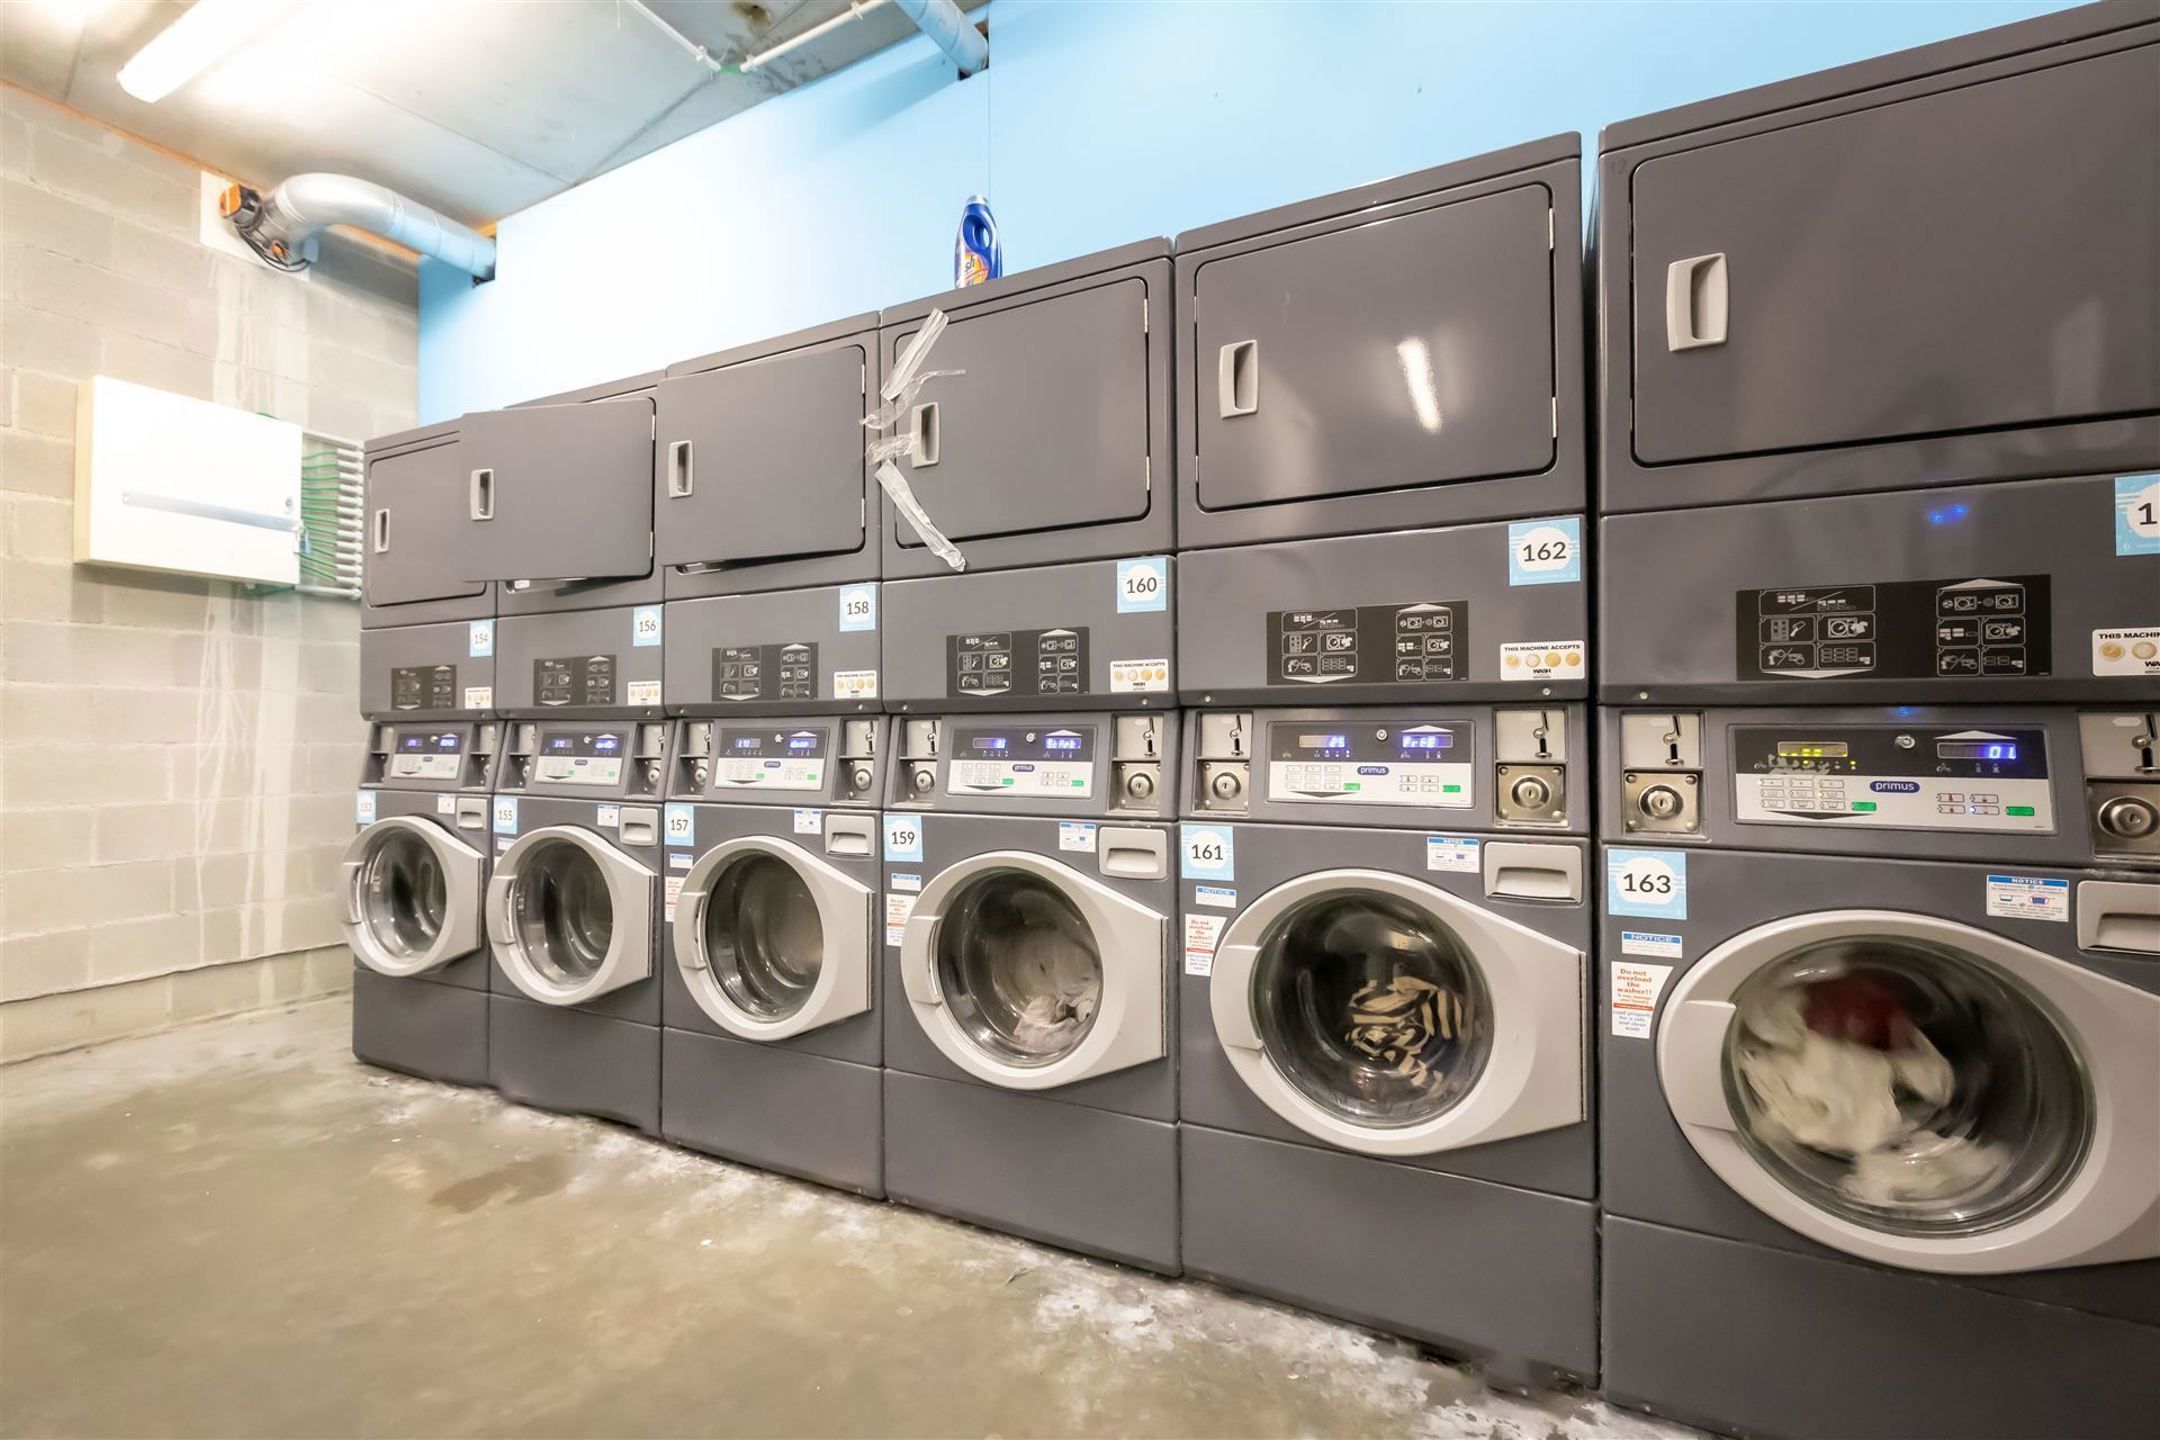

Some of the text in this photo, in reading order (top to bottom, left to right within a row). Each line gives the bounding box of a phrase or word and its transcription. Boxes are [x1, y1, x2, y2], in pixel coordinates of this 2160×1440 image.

[1523, 541, 1567, 562] 162
[1126, 577, 1158, 593] 160
[846, 601, 869, 615] 158
[639, 620, 657, 632] 156
[1360, 765, 1387, 775] primus
[1875, 780, 1915, 792] primus
[498, 809, 513, 821] 155
[671, 819, 688, 831] 157
[891, 831, 915, 845] 159
[1191, 843, 1224, 860] 161
[1623, 872, 1672, 894] 163
[1631, 934, 1672, 943] NOTICE
[1617, 974, 1653, 983] overload
